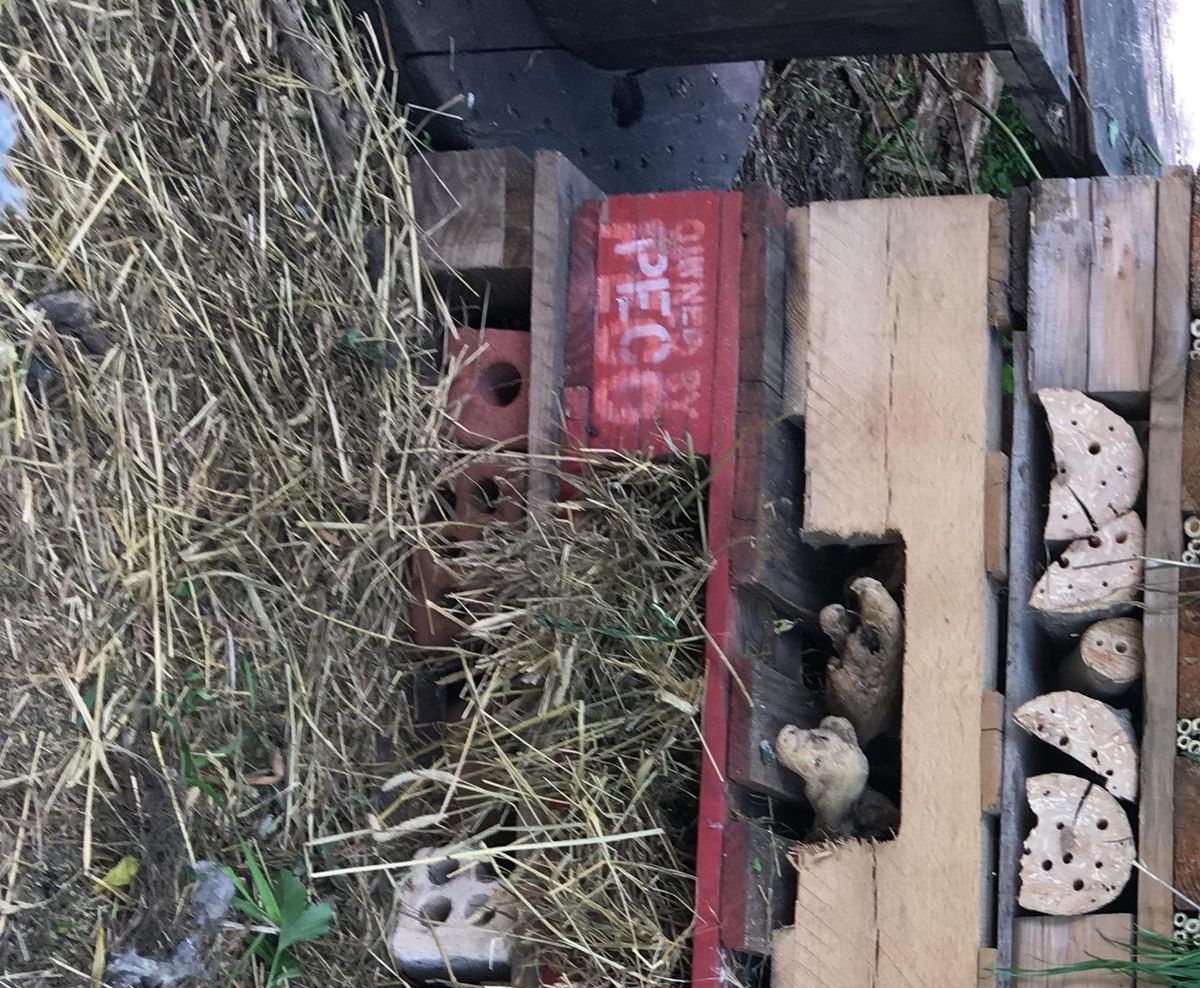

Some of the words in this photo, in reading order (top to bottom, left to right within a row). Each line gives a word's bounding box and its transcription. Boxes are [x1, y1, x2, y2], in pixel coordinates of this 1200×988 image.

[597, 218, 672, 424] PECO
[673, 218, 706, 356] OWNED
[668, 369, 702, 419] BY
